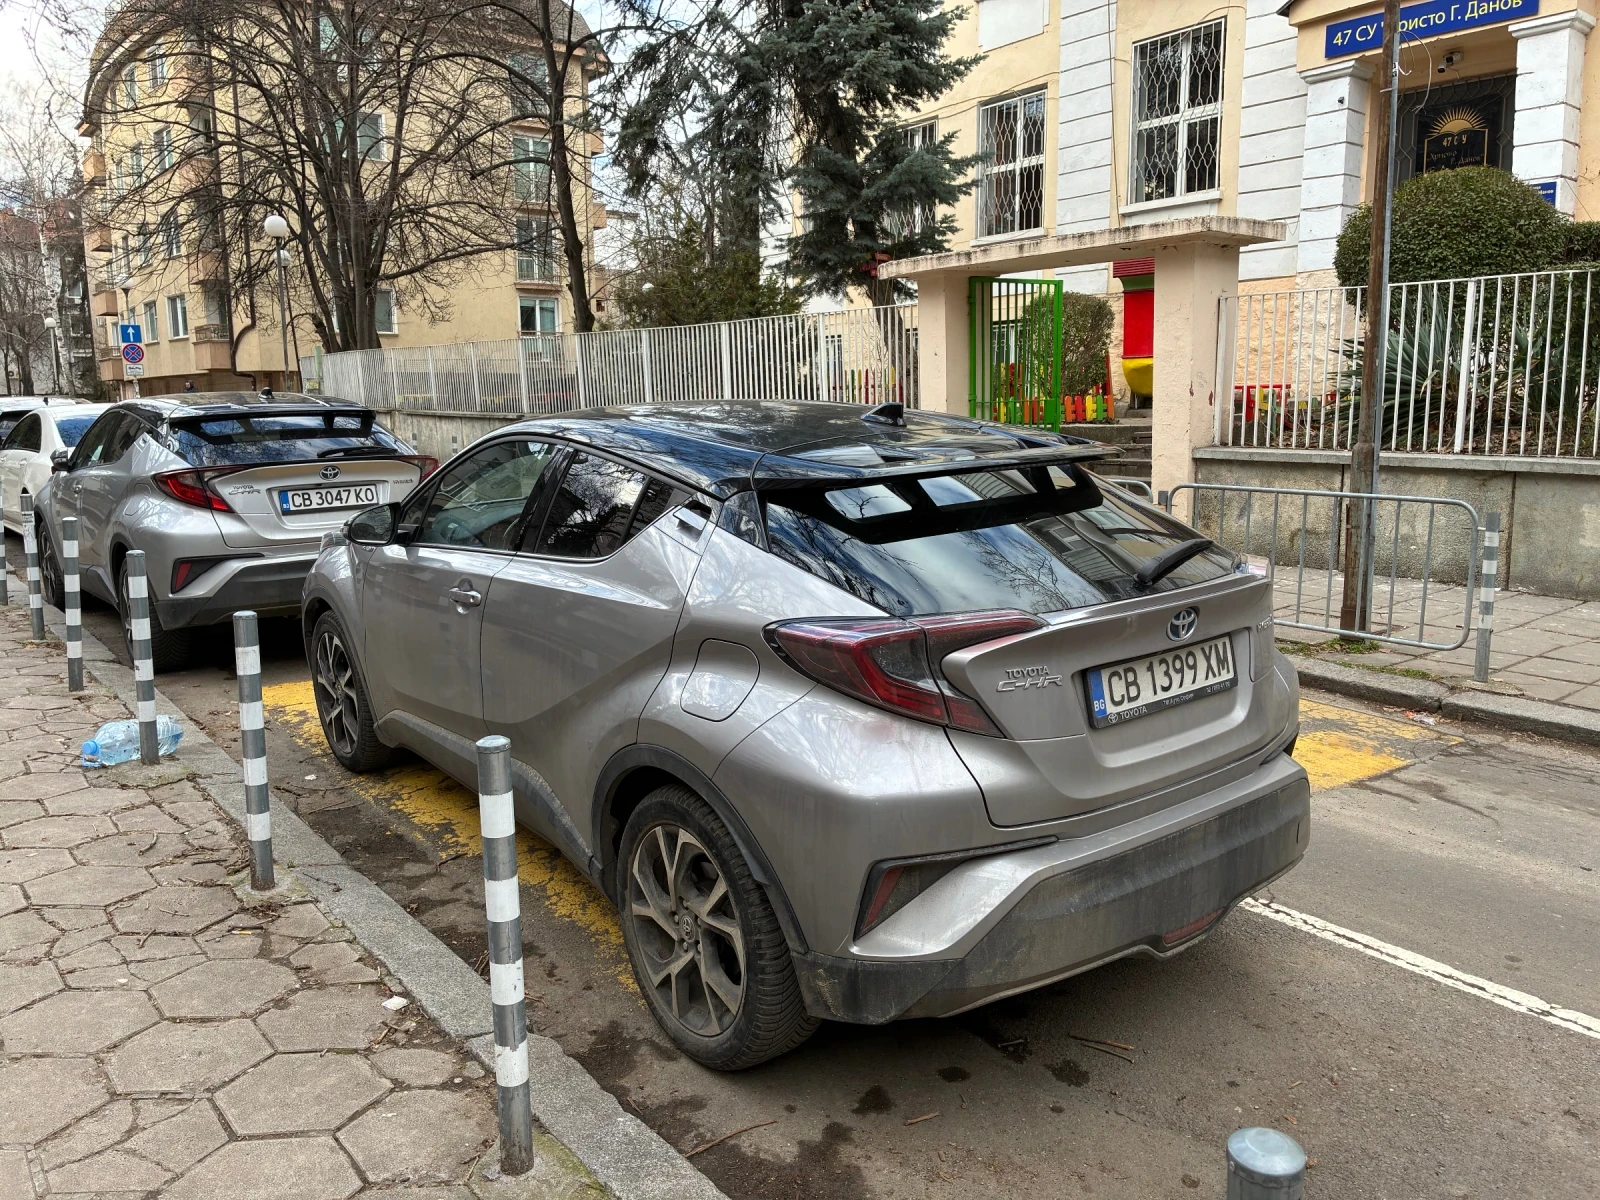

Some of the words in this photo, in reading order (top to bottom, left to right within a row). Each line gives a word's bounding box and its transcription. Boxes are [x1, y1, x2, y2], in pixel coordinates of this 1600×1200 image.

[1333, 31, 1352, 46] 47
[1356, 22, 1378, 41] СУ
[1451, 4, 1462, 21] Г.
[1465, 0, 1523, 21] Данов
[1442, 136, 1452, 147] 47
[291, 492, 313, 508] CB
[315, 488, 352, 506] 3047
[354, 487, 375, 503] KO
[1006, 665, 1050, 679] TOYOTA
[1093, 699, 1106, 712] BG
[1107, 666, 1141, 707] CB
[1146, 650, 1198, 696] 1399
[1200, 641, 1231, 681] XM
[996, 674, 1063, 693] C-HR
[1119, 706, 1148, 720] TOYOTA
